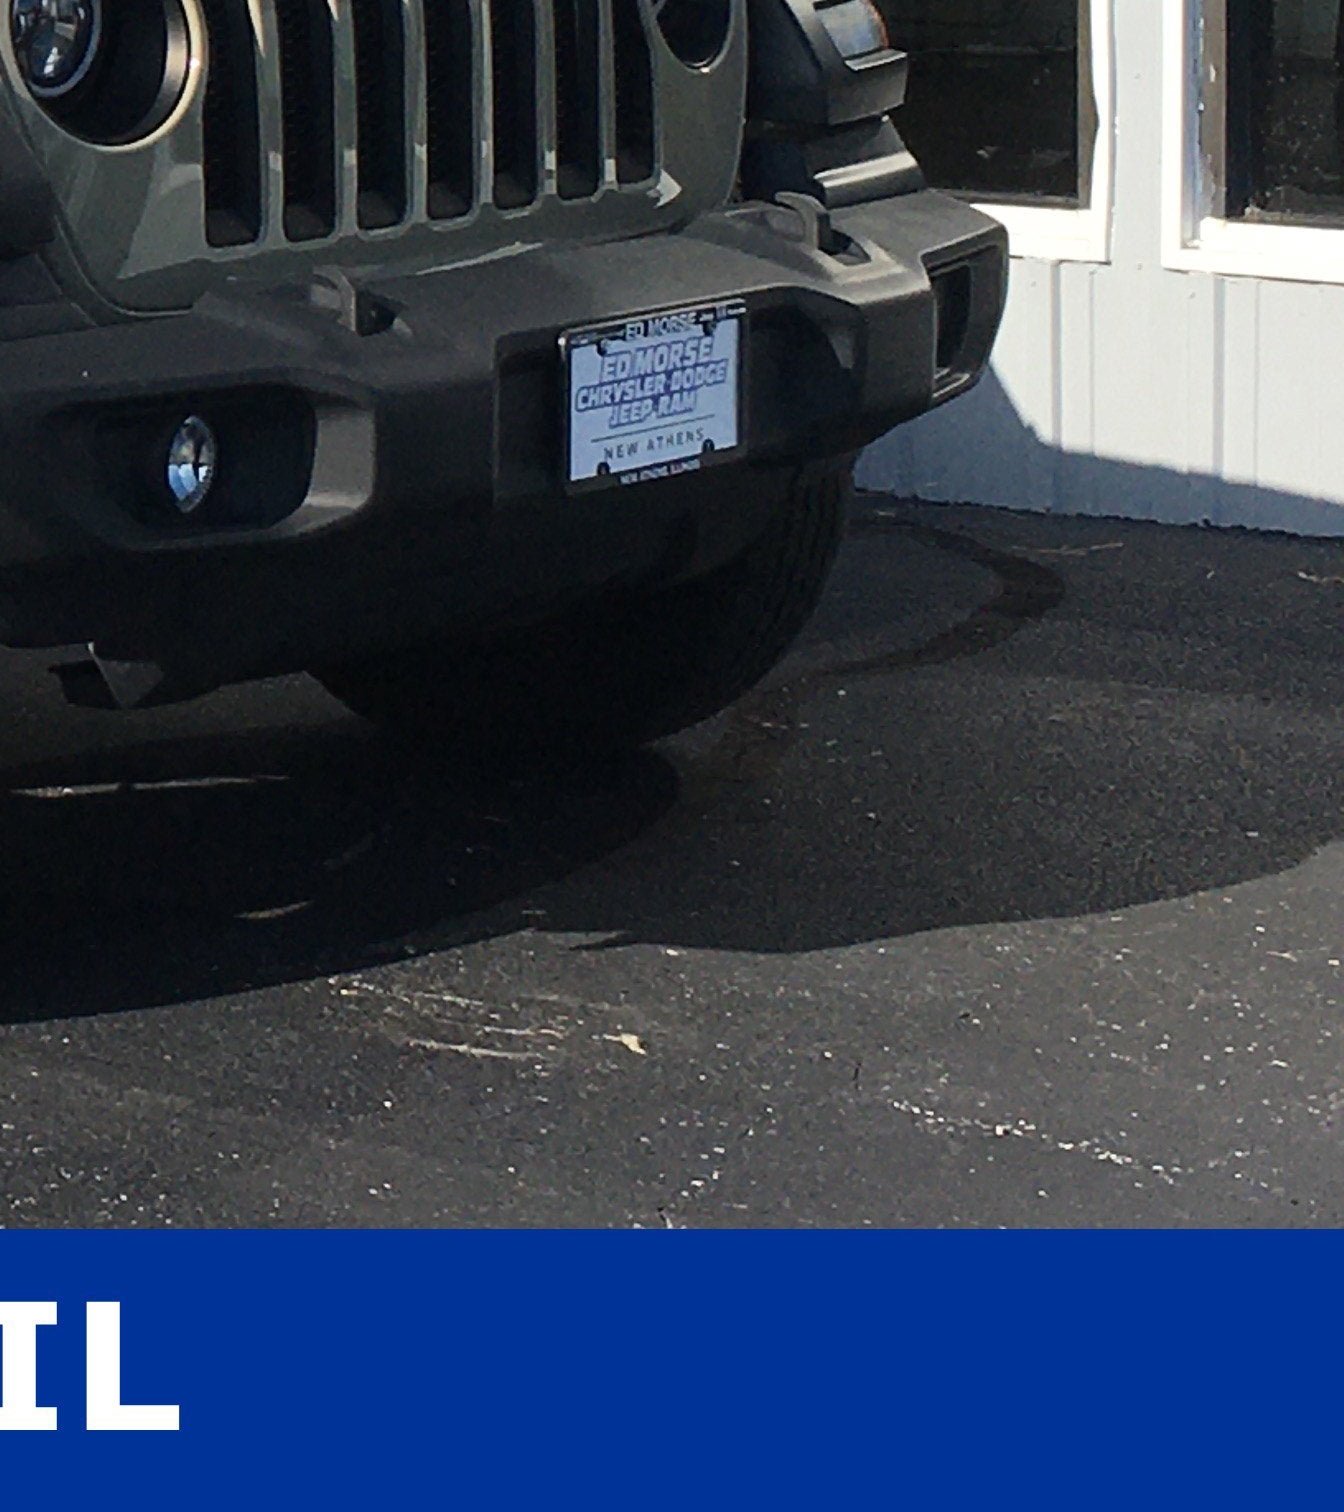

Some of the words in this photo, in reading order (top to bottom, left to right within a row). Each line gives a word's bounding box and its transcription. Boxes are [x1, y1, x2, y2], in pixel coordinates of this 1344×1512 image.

[601, 350, 632, 381] ED
[635, 336, 714, 376] MORSE
[576, 373, 668, 412] CHRYSLER
[670, 359, 728, 393] DODGE
[609, 398, 653, 429] JEEP
[656, 390, 698, 419] RAM
[604, 441, 638, 461] NEW
[646, 427, 705, 452] ATHENS
